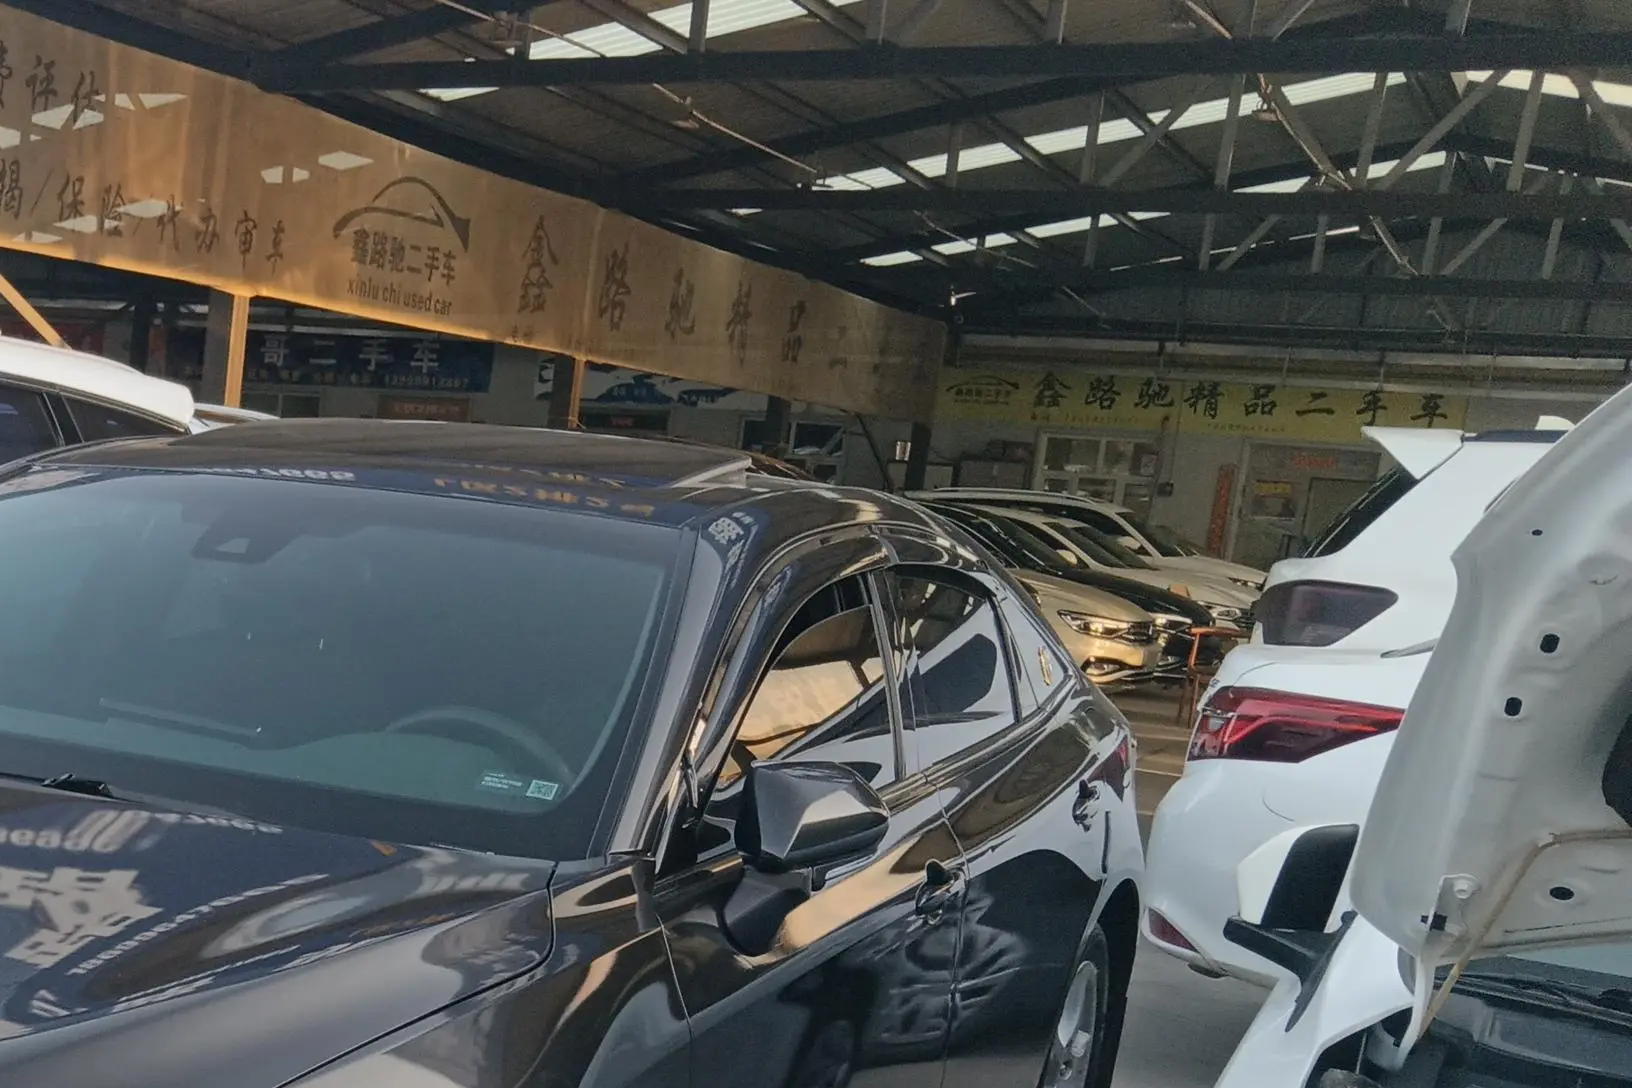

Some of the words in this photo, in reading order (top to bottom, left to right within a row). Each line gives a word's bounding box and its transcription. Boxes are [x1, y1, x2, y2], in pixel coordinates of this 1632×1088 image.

[1034, 371, 1448, 428] 鑫路驰精品二手车
